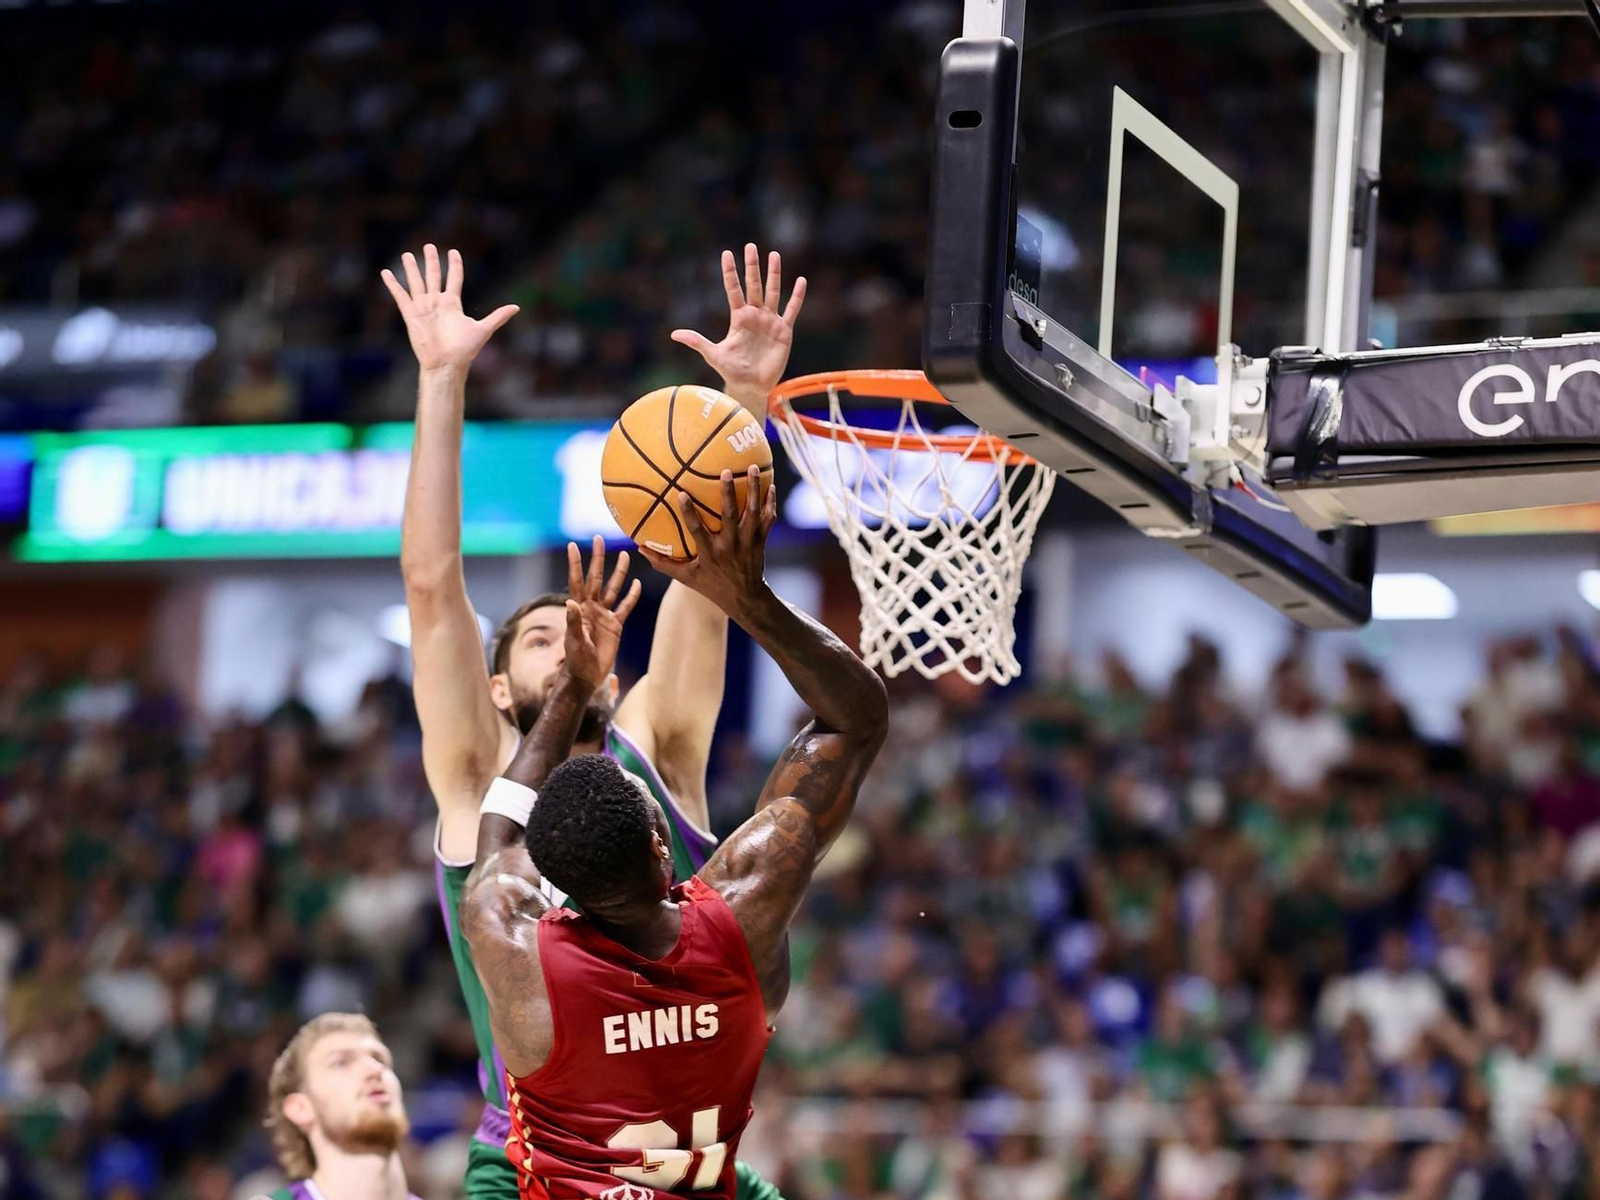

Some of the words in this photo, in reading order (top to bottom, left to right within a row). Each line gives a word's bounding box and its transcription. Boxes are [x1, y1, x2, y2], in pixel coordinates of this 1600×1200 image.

[1457, 358, 1600, 437] en
[603, 1003, 719, 1055] ENNIS
[605, 1105, 728, 1191] 31
